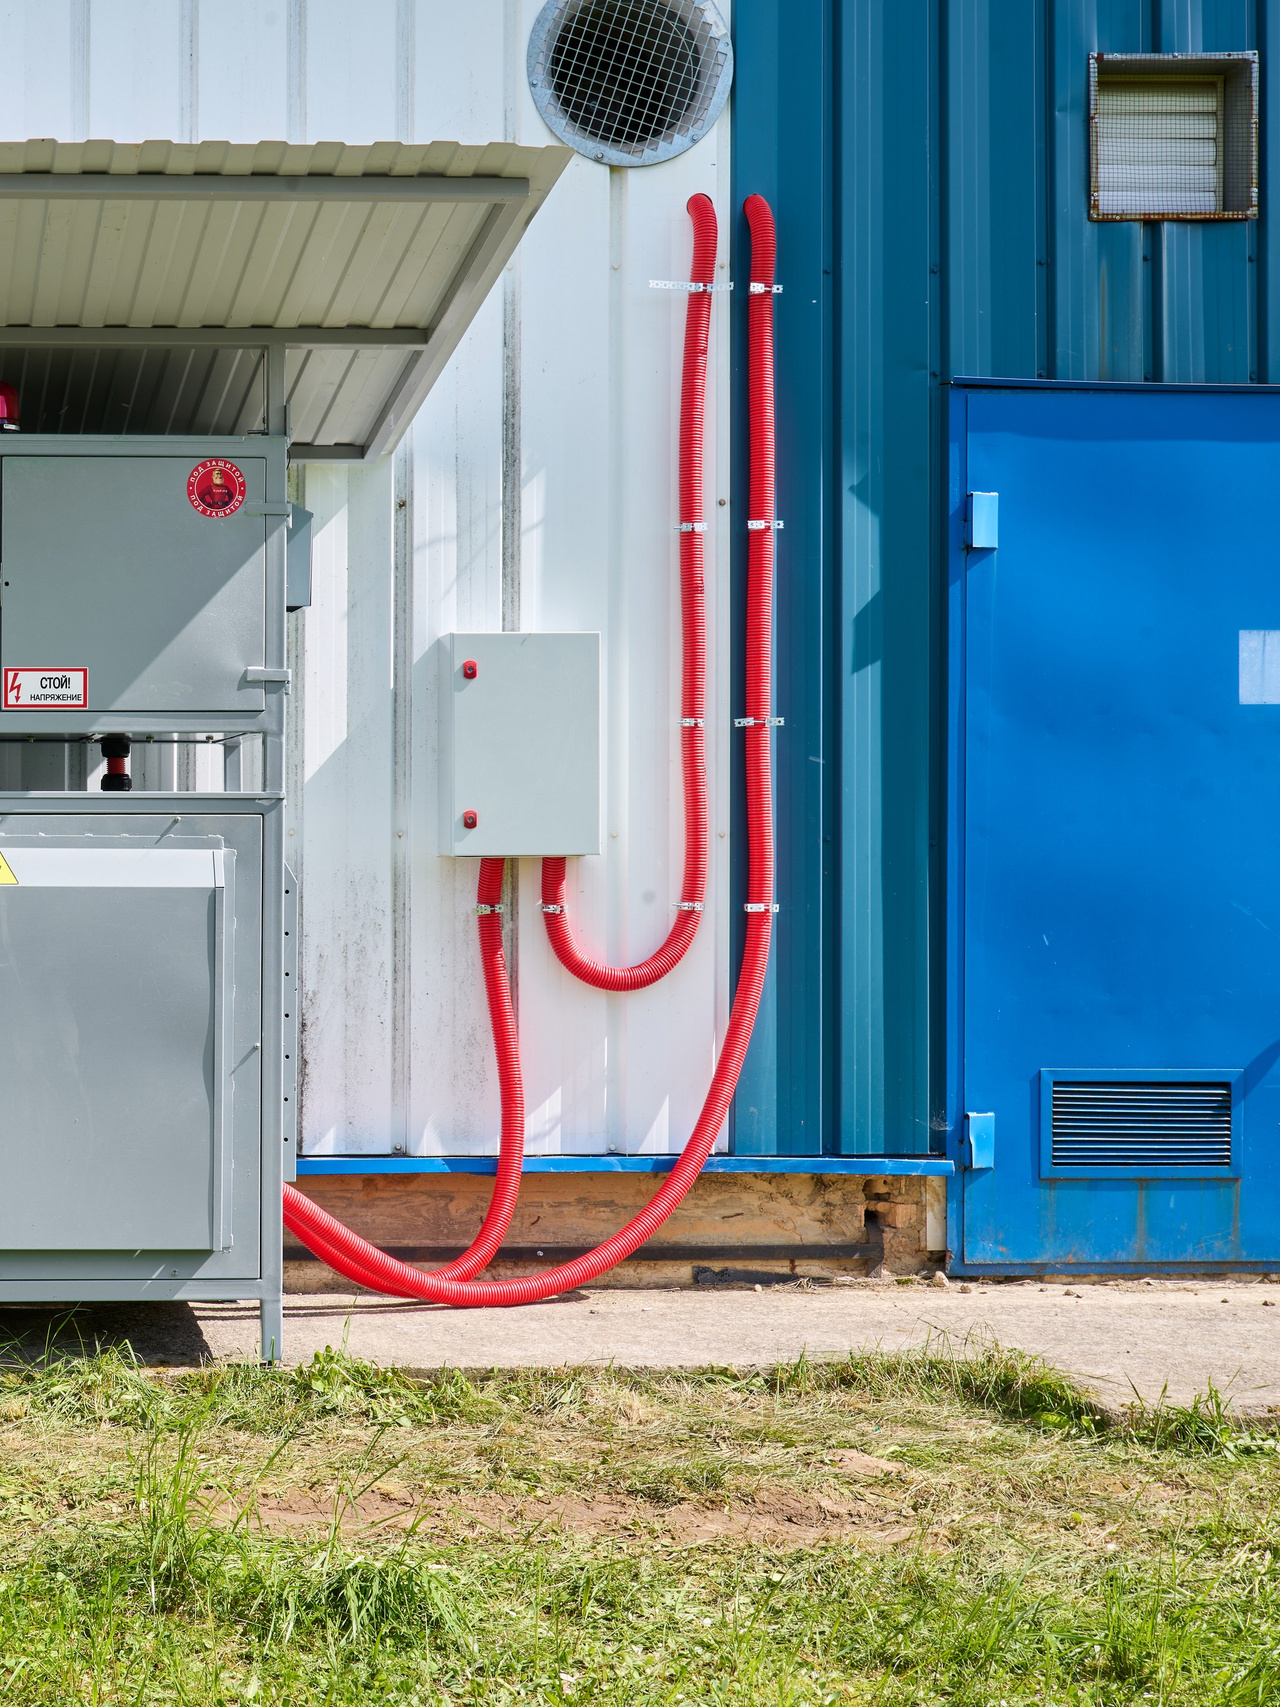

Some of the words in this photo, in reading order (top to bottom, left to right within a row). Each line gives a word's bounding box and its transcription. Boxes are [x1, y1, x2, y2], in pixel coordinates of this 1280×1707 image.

[190, 466, 204, 482] ПОД
[206, 460, 245, 483] ЗАЩИТОЙ
[190, 495, 204, 512] ПОД
[206, 495, 244, 517] ЗАЩИТОЙ
[40, 675, 71, 689] СТОЙ!
[30, 693, 82, 701] НАПРЯЖЕНИЕ
